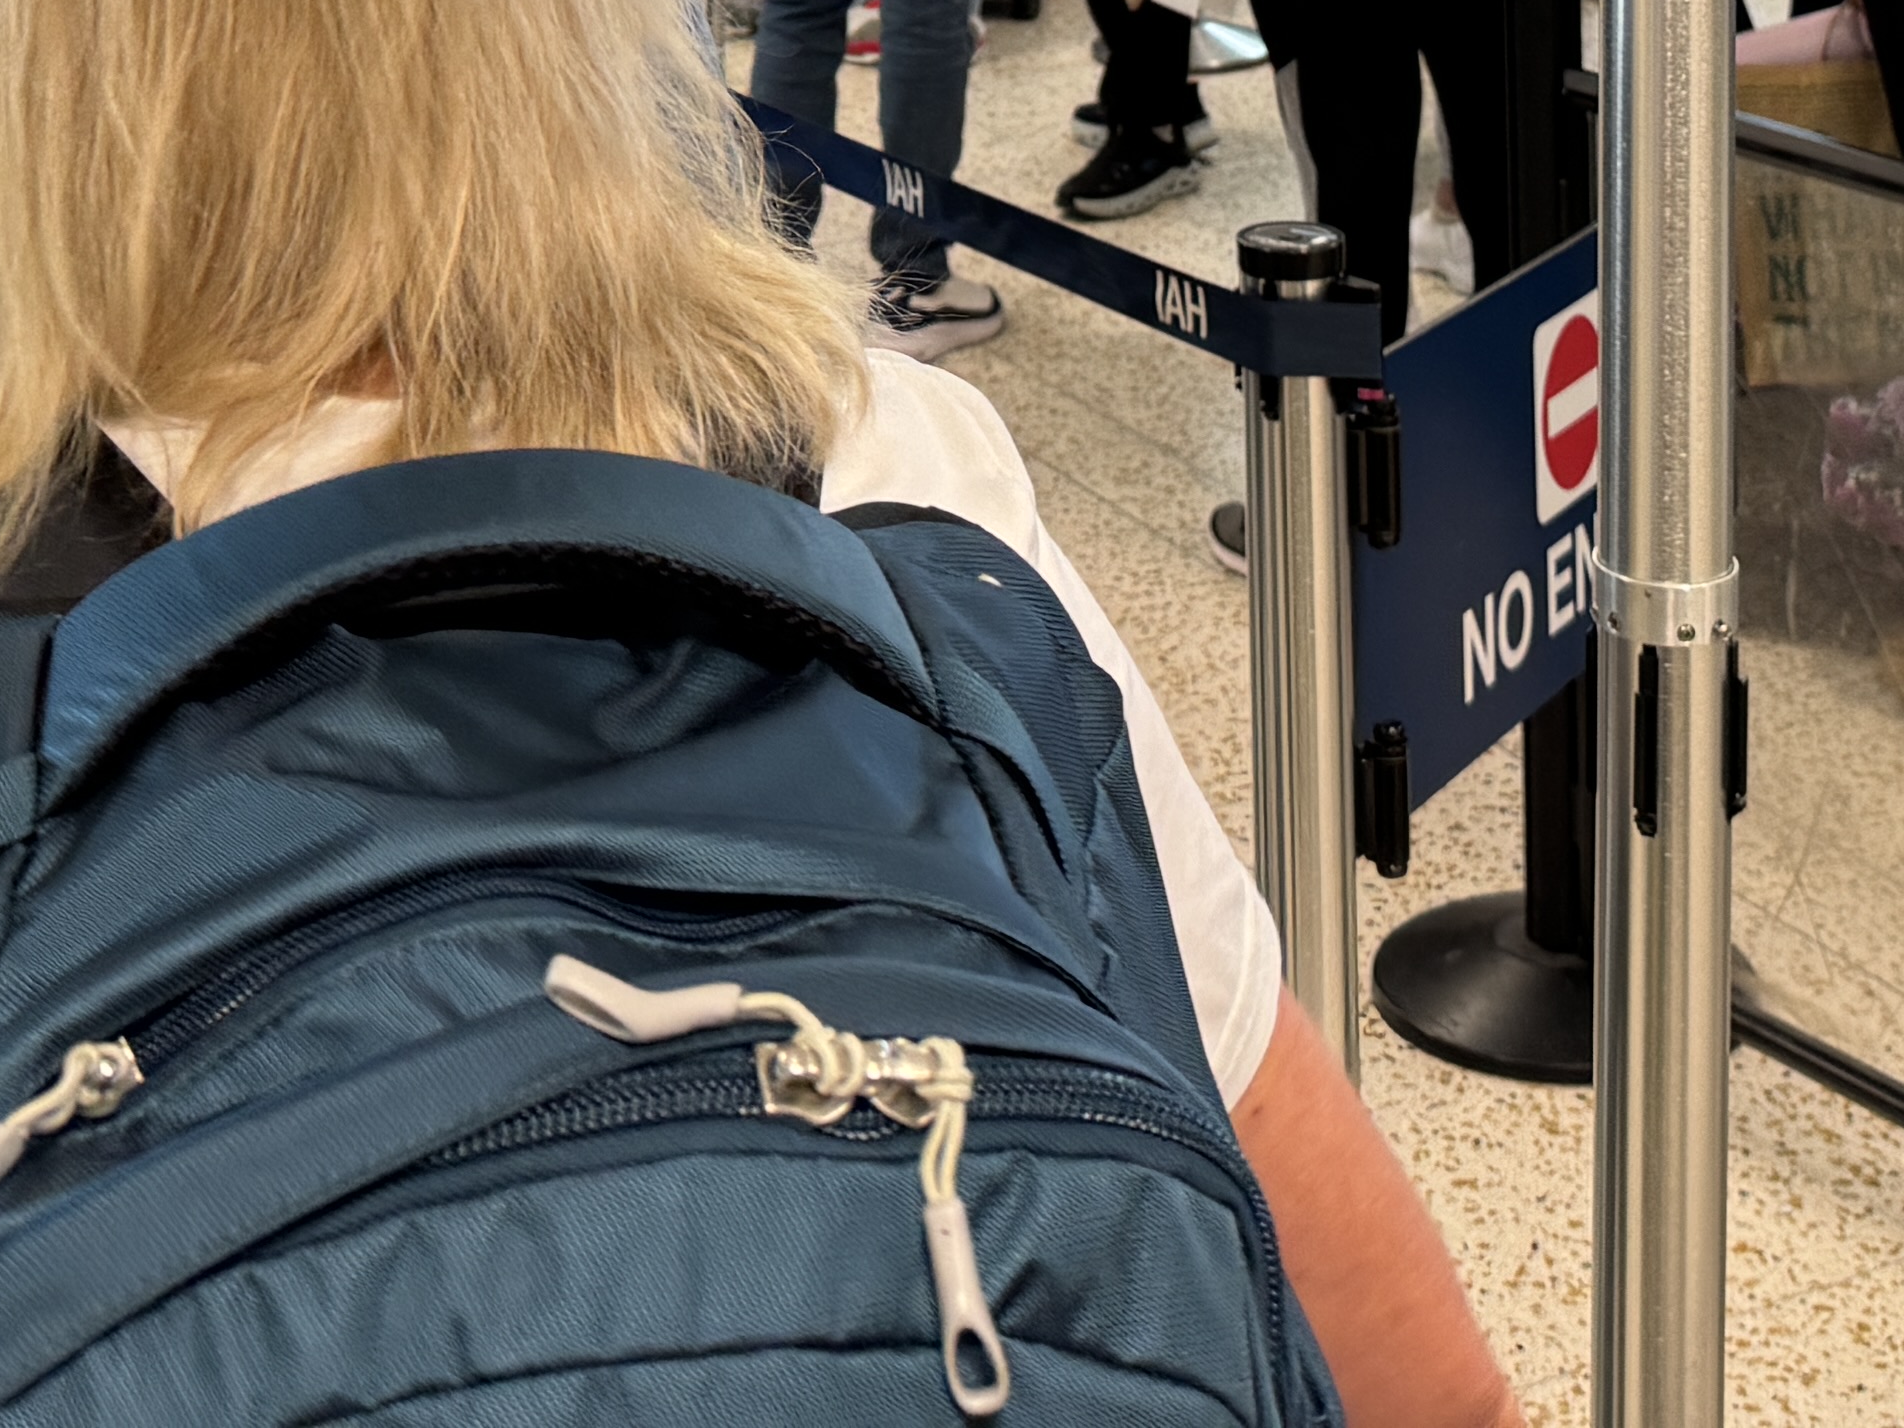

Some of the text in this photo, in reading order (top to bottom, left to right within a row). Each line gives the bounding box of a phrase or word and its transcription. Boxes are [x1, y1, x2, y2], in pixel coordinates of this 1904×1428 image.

[881, 157, 925, 220] IAH
[1155, 268, 1209, 341] IAH
[1461, 569, 1534, 706] NO
